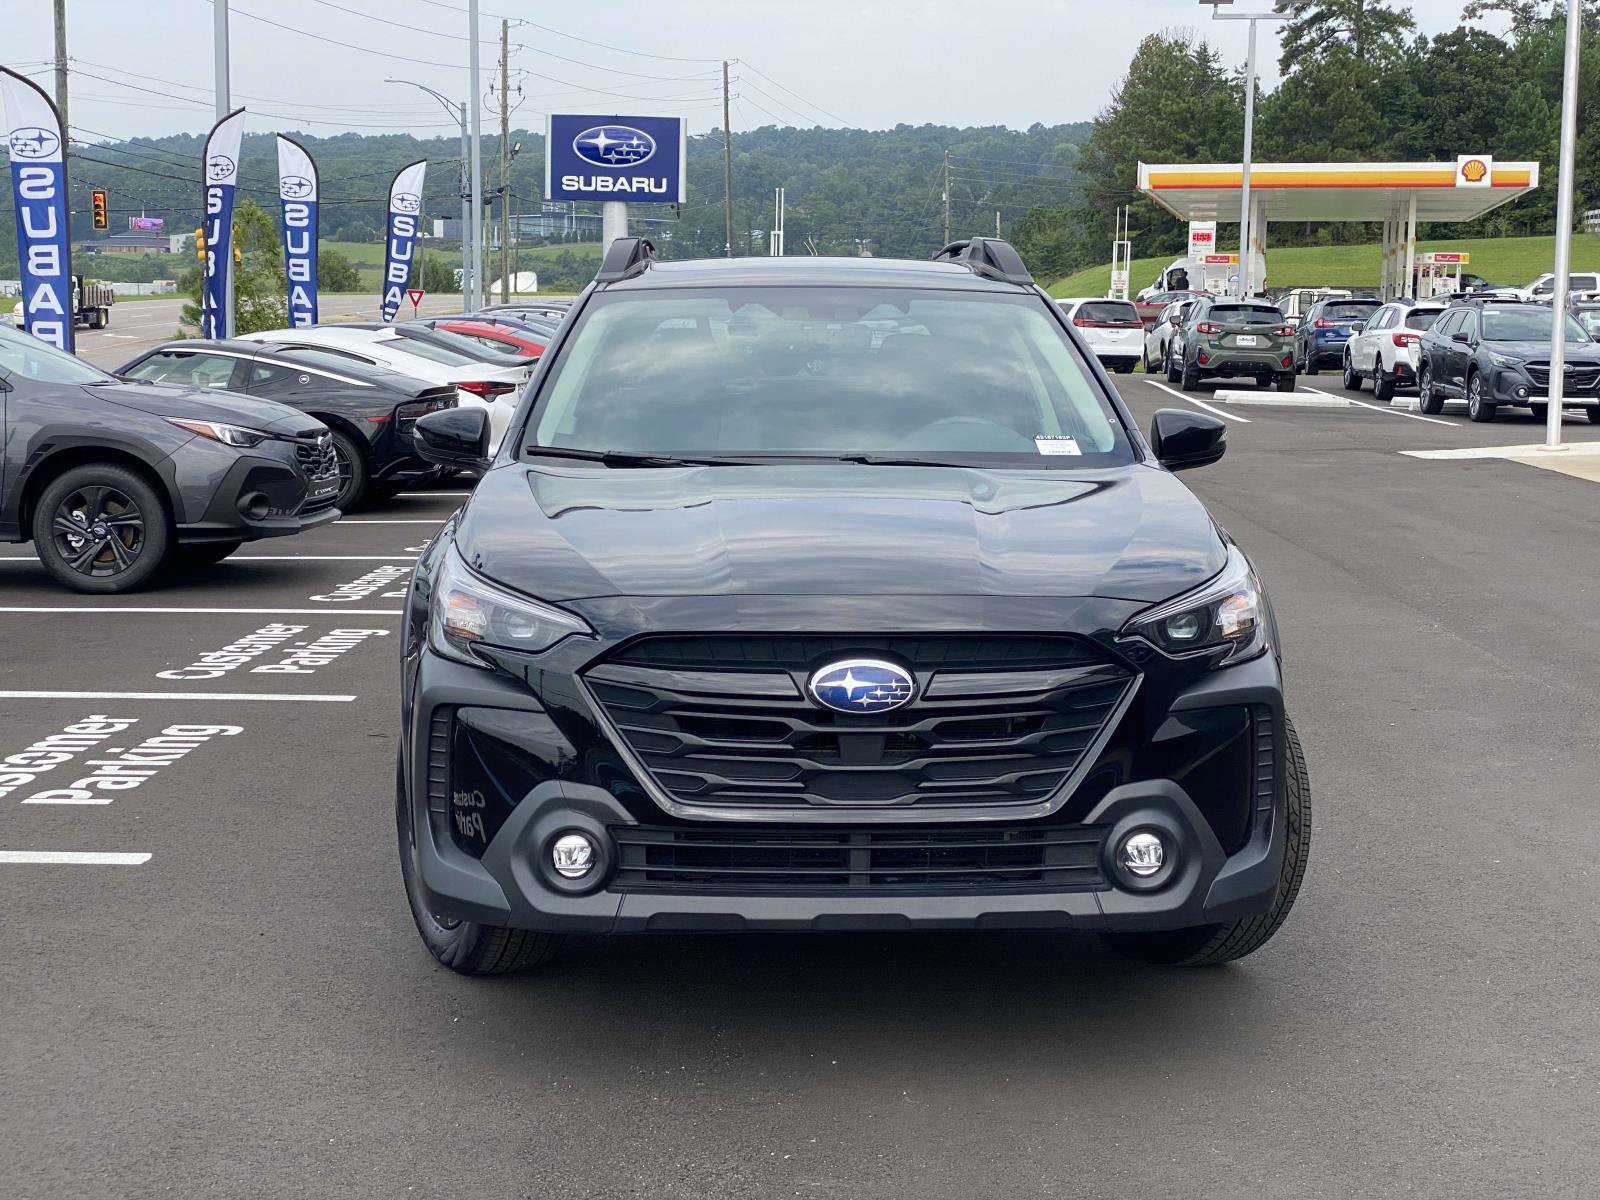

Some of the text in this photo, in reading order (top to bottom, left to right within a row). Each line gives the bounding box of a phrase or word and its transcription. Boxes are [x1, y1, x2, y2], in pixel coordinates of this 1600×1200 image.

[561, 175, 667, 193] SUBARU
[155, 623, 309, 680] Customer
[249, 628, 391, 674] Parking
[20, 724, 244, 805] Parking
